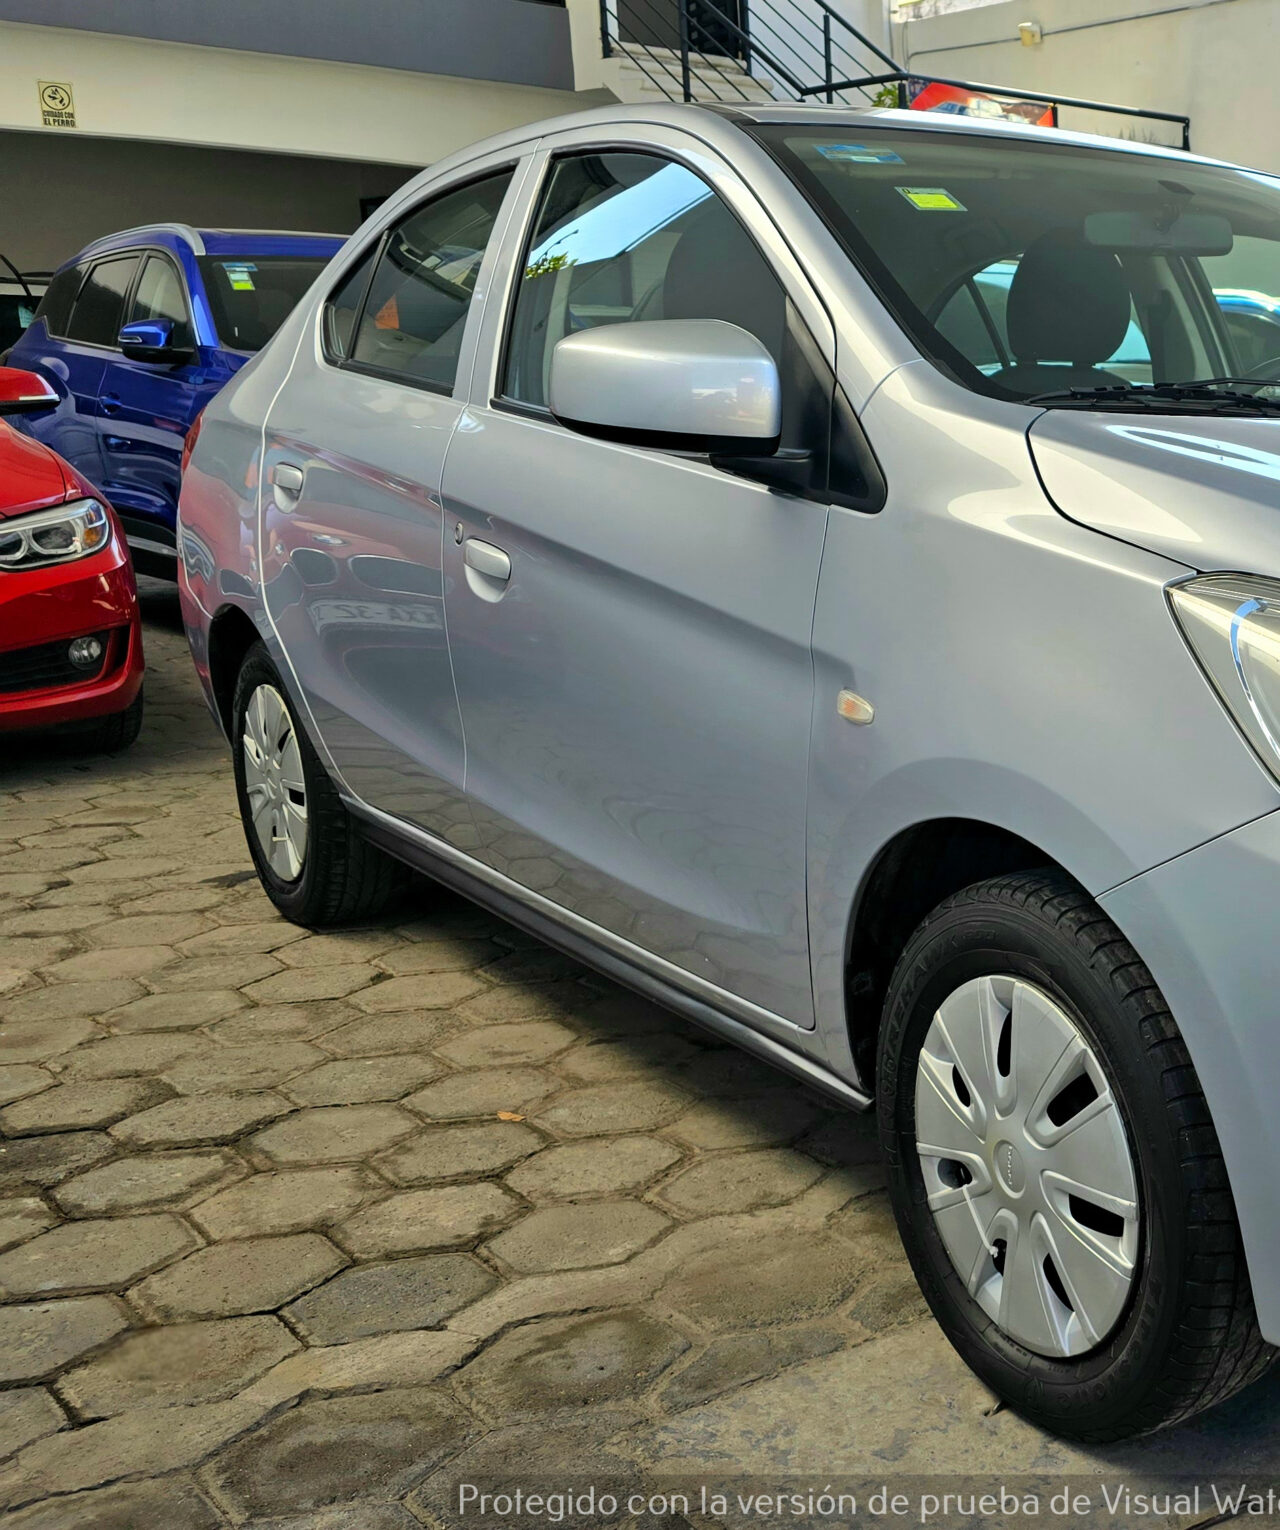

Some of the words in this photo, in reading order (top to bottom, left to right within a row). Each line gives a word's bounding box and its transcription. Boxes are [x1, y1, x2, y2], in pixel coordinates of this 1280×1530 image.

[43, 110, 64, 118] CUIDADO
[64, 111, 75, 119] CON
[44, 118, 52, 126] EL
[53, 119, 76, 128] PERRO
